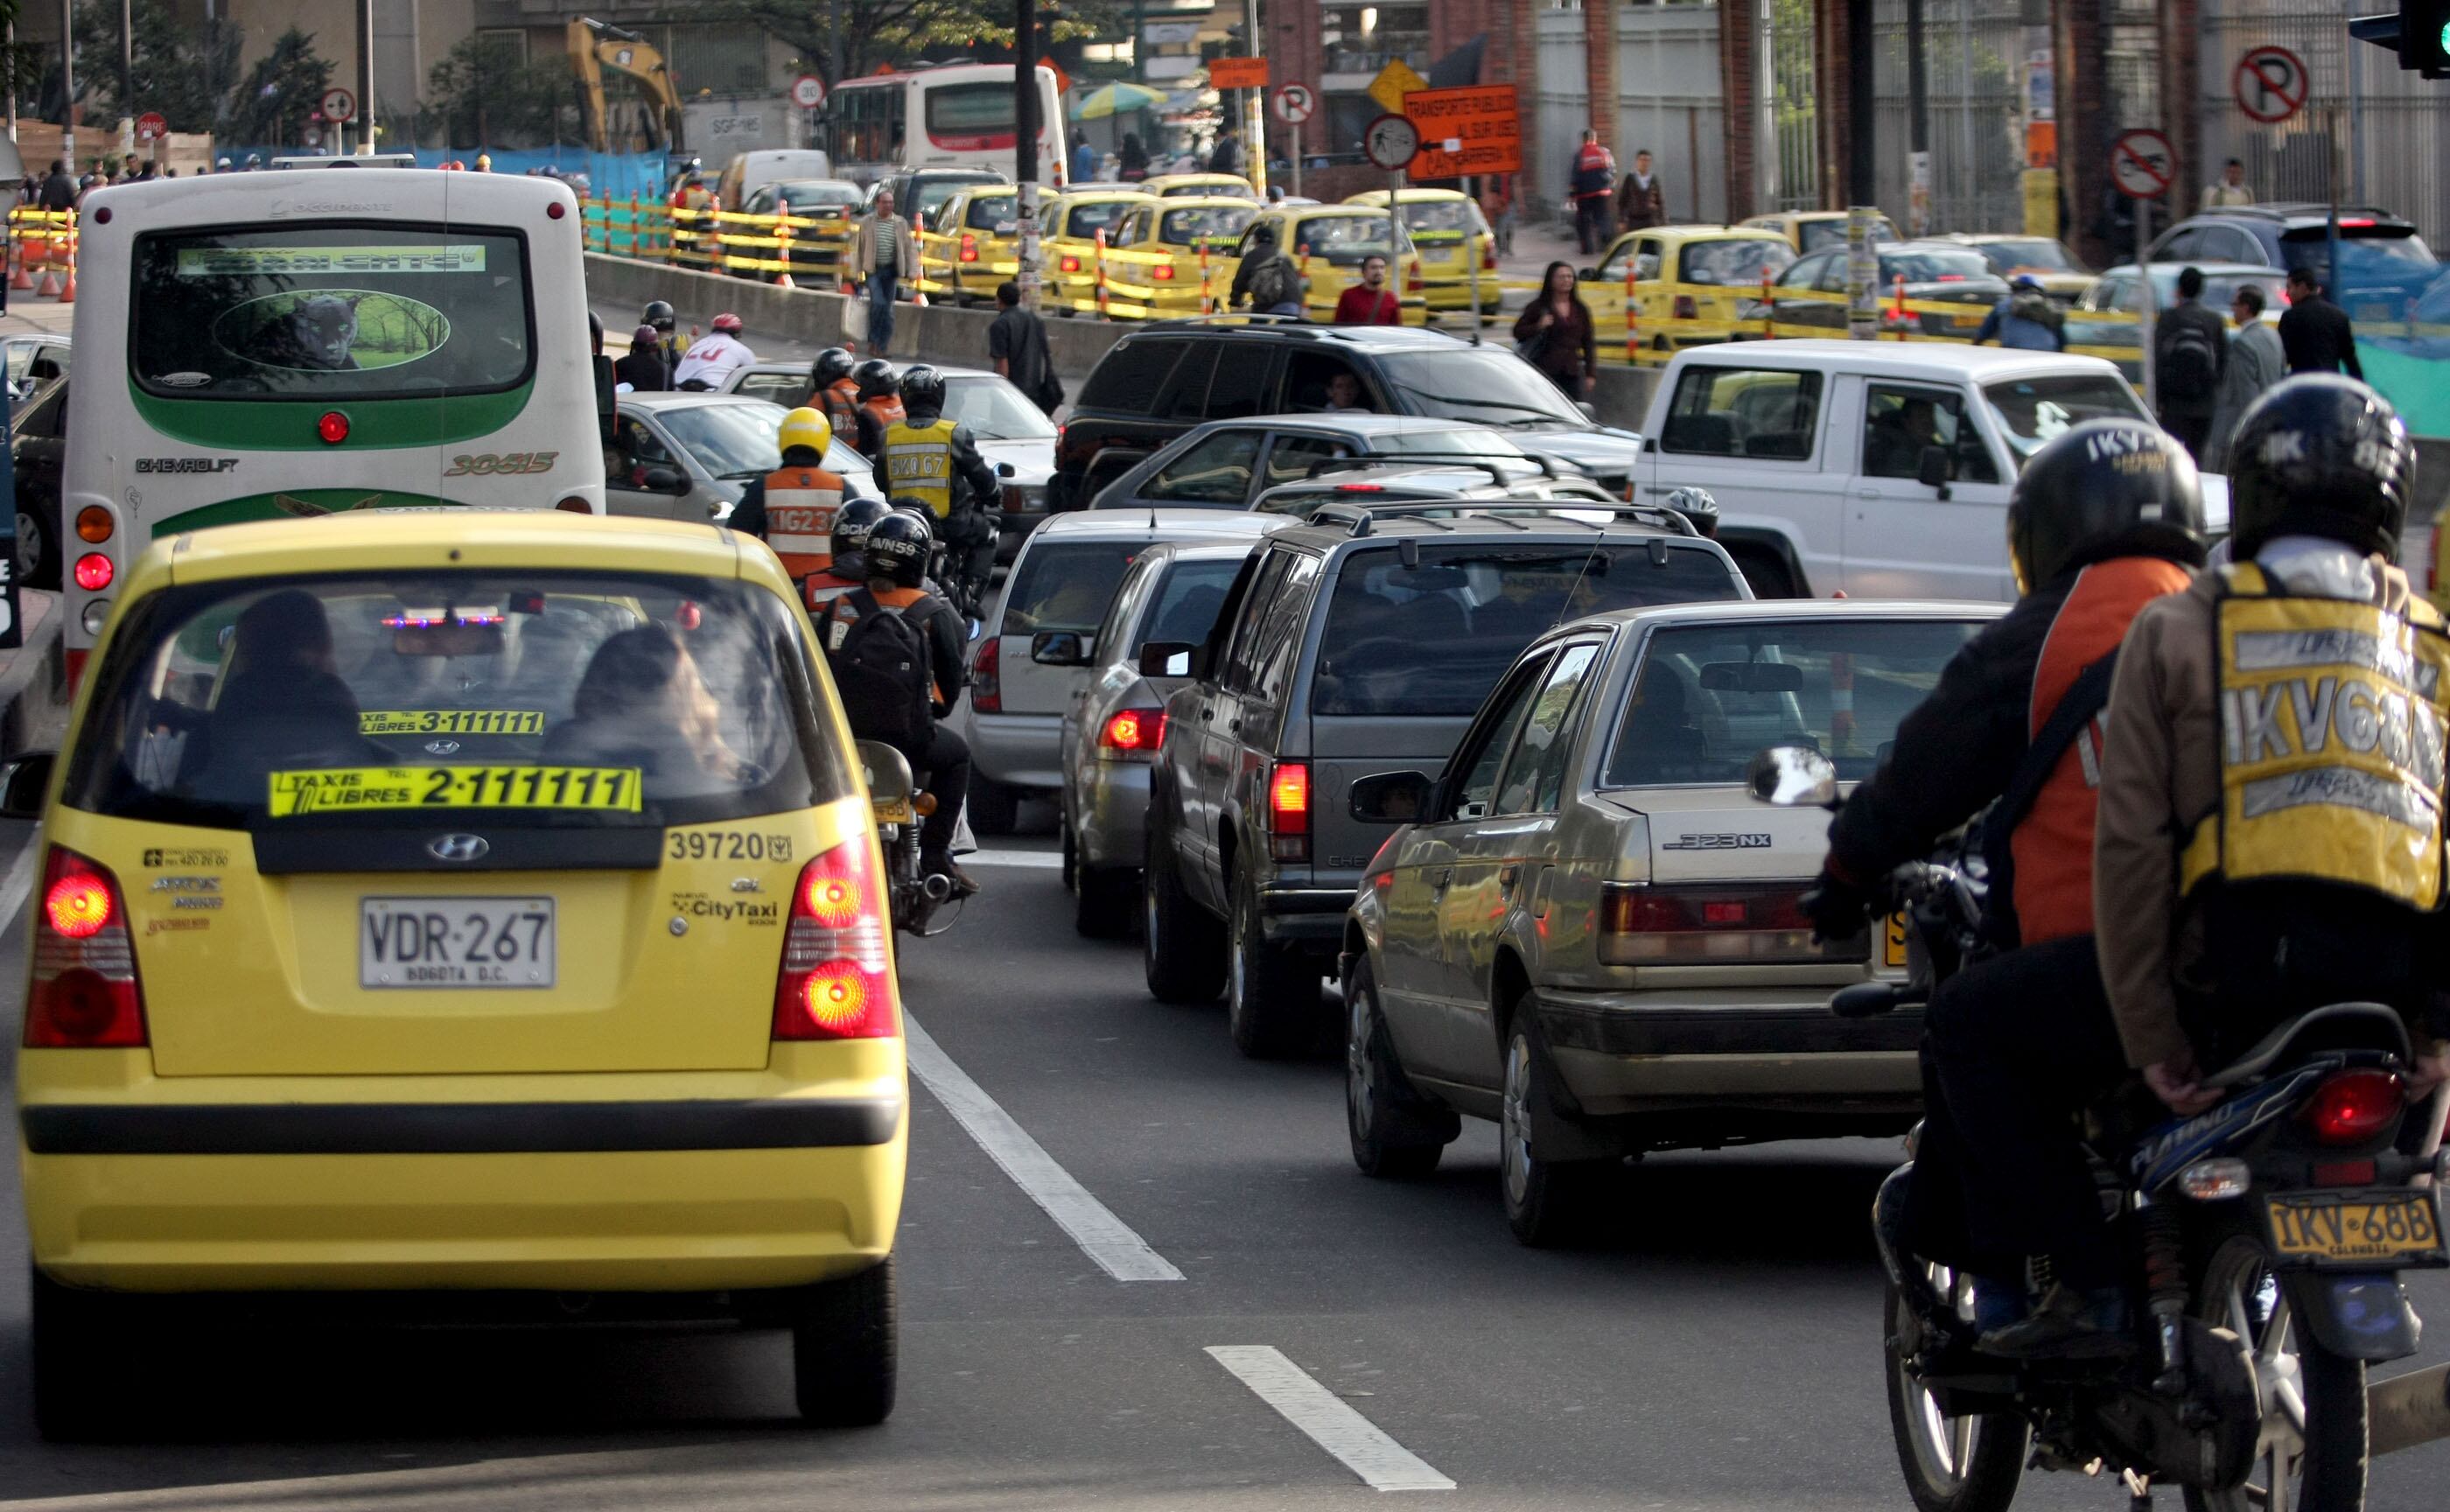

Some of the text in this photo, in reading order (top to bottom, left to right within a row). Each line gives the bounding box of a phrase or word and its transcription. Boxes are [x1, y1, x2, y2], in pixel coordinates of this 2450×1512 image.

[1408, 97, 1471, 119] TRANSPORTE
[871, 536, 916, 557] AVN59
[360, 721, 416, 733] LIBRES
[291, 773, 363, 789] TAXIS
[318, 787, 413, 805] LIBRES
[669, 831, 764, 859] 39720
[693, 900, 778, 920] CityTaxi
[406, 966, 467, 981] BOGOTA
